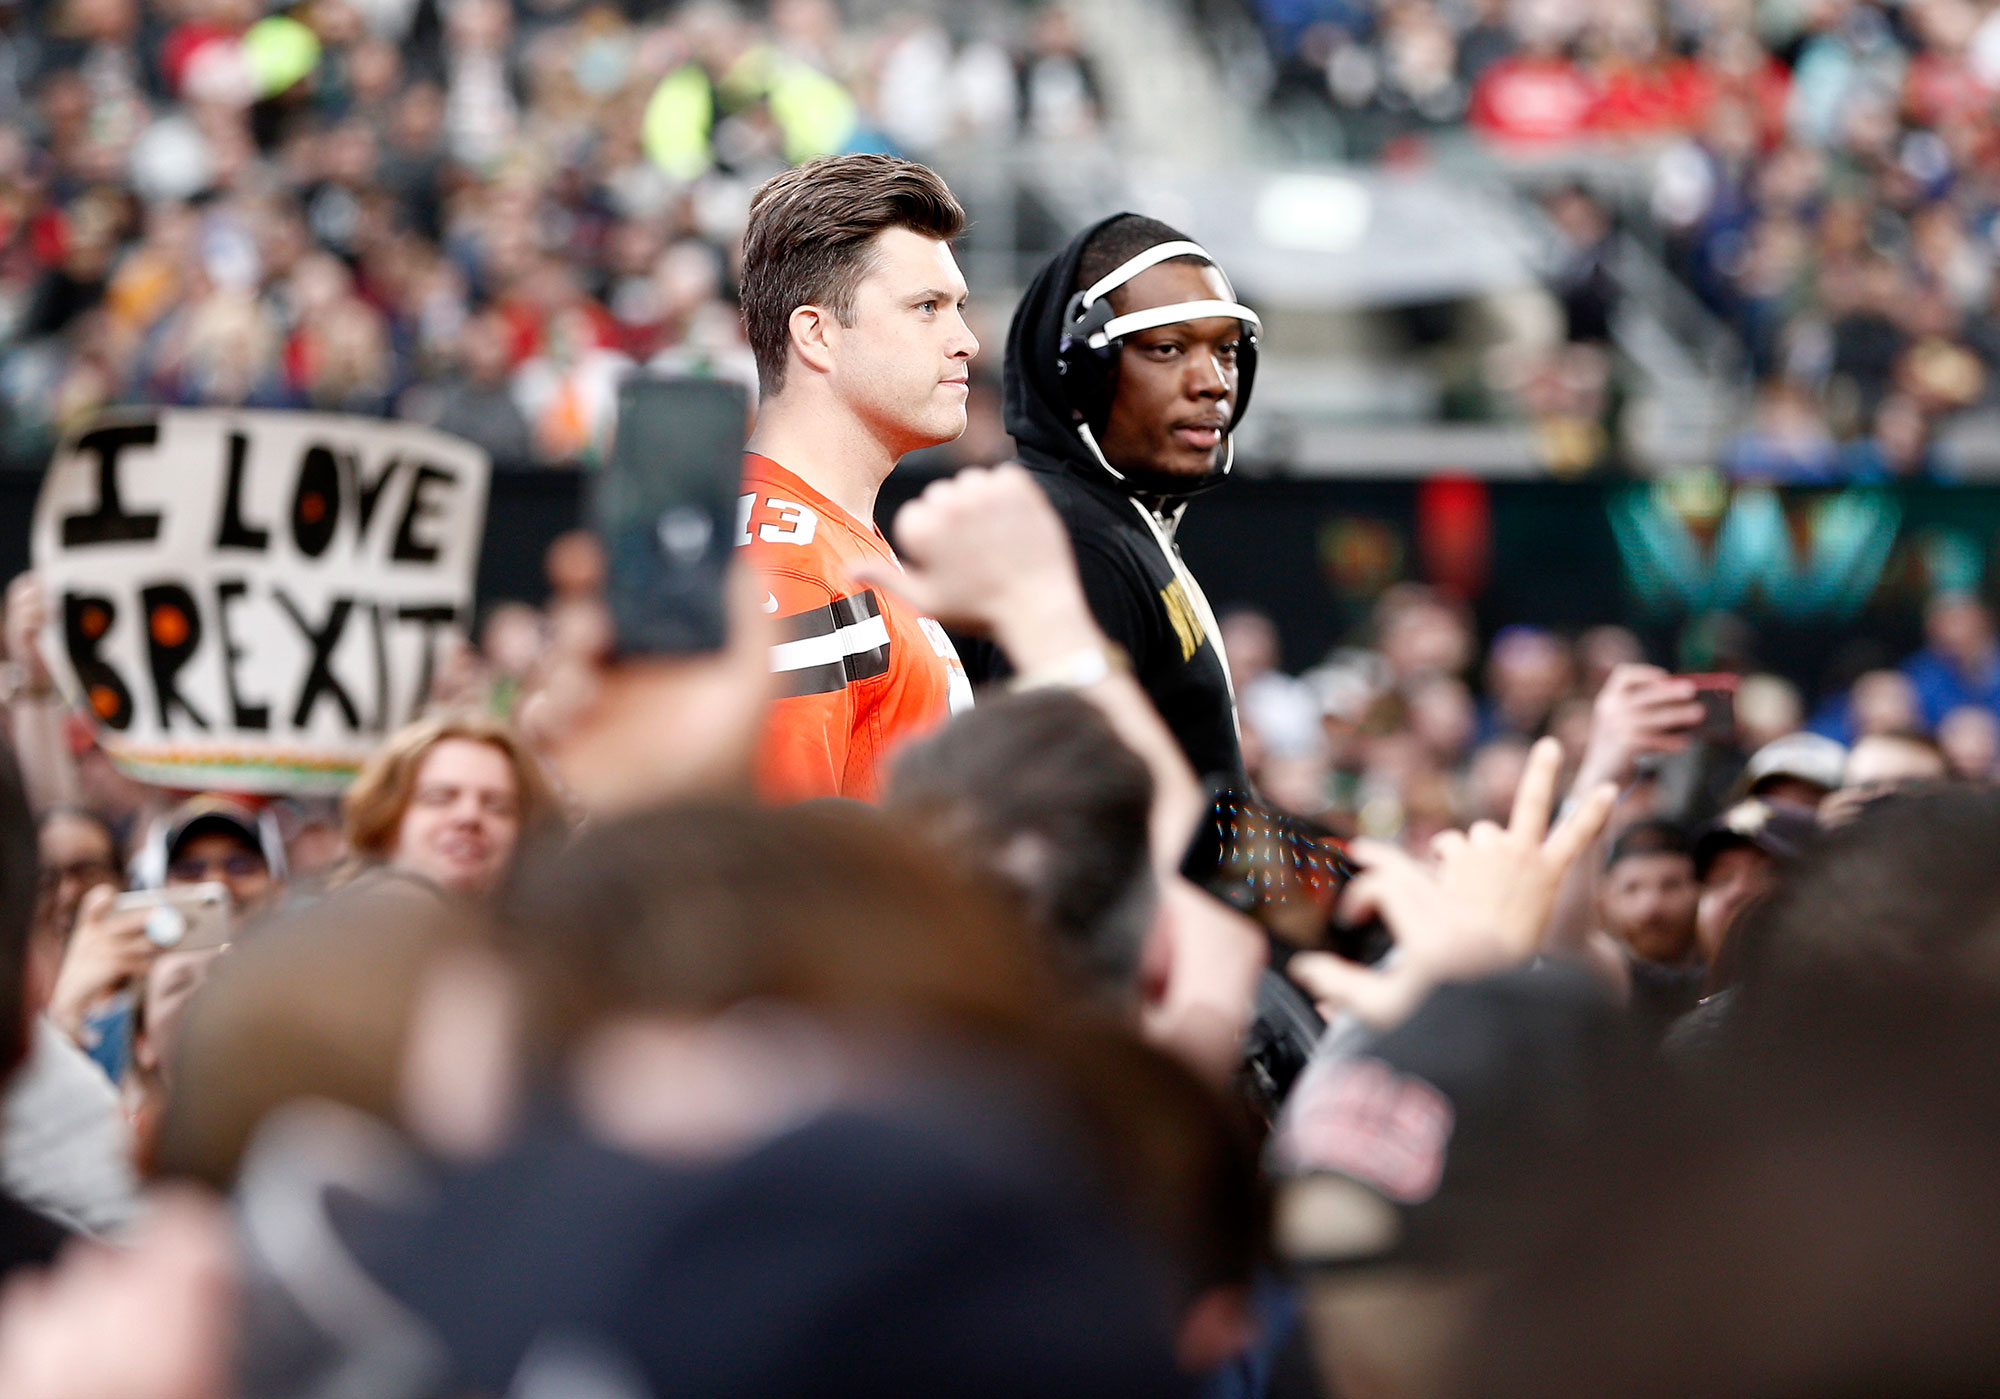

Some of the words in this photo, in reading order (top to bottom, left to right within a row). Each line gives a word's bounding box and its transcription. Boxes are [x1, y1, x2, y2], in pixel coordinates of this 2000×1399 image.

[62, 424, 161, 547] I
[216, 431, 458, 562] LOVE
[734, 491, 818, 547] 13
[62, 576, 455, 733] BREXIT
